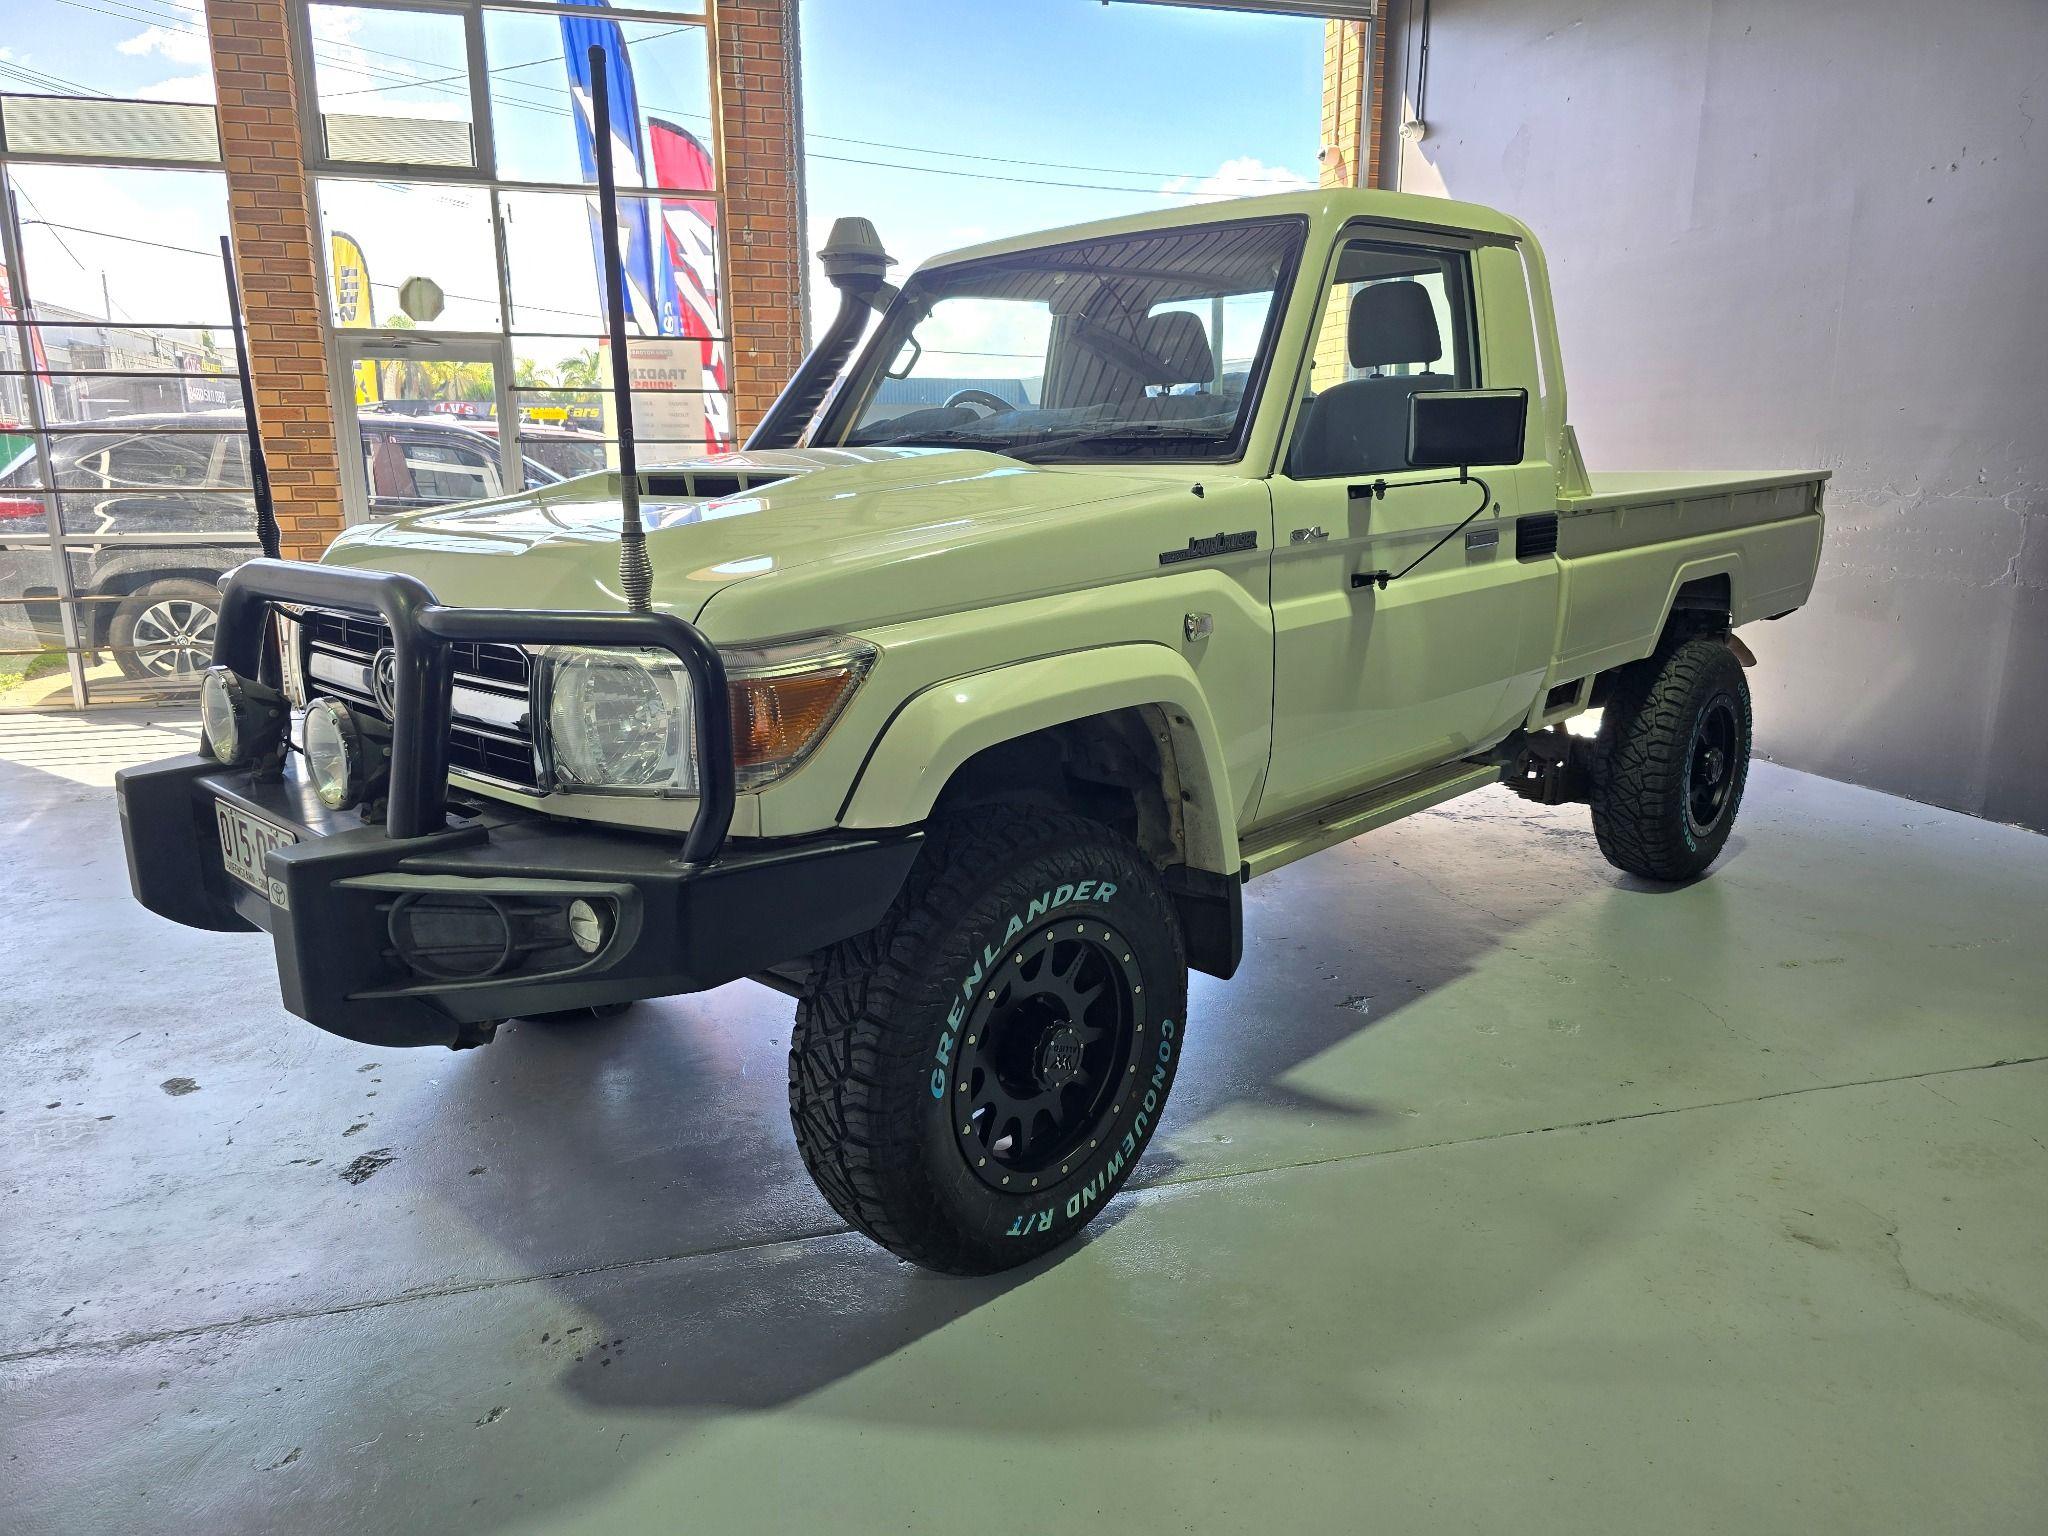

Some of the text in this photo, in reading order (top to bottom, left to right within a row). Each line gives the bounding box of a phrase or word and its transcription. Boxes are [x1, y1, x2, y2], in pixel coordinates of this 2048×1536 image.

[930, 880, 1118, 1099] GRENLANDER
[1006, 1018, 1176, 1237] CONQUEWIND R/T
